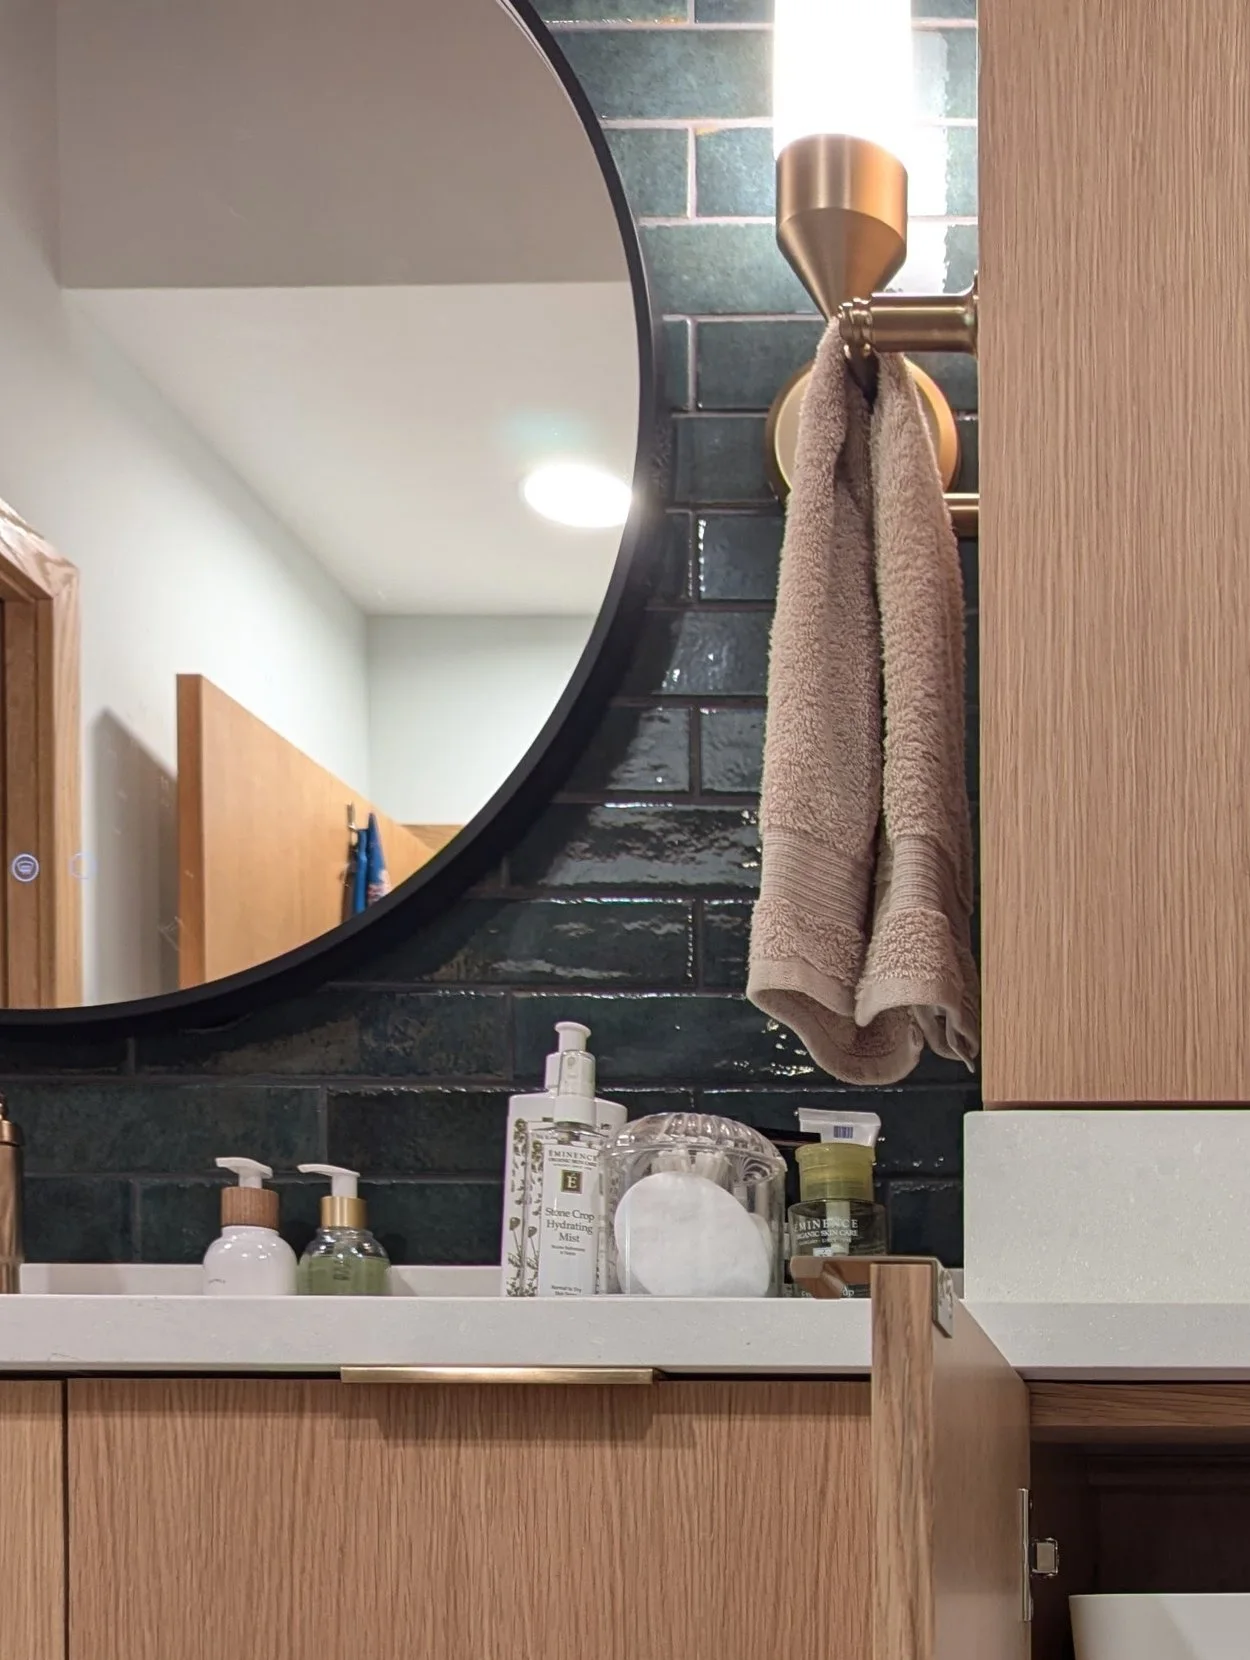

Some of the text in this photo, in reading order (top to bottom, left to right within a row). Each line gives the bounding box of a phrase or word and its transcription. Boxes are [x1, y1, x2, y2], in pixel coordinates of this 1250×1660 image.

[545, 1207, 595, 1223] Stone Crop
[546, 1219, 593, 1235] Hydrating
[559, 1232, 580, 1243] Mist
